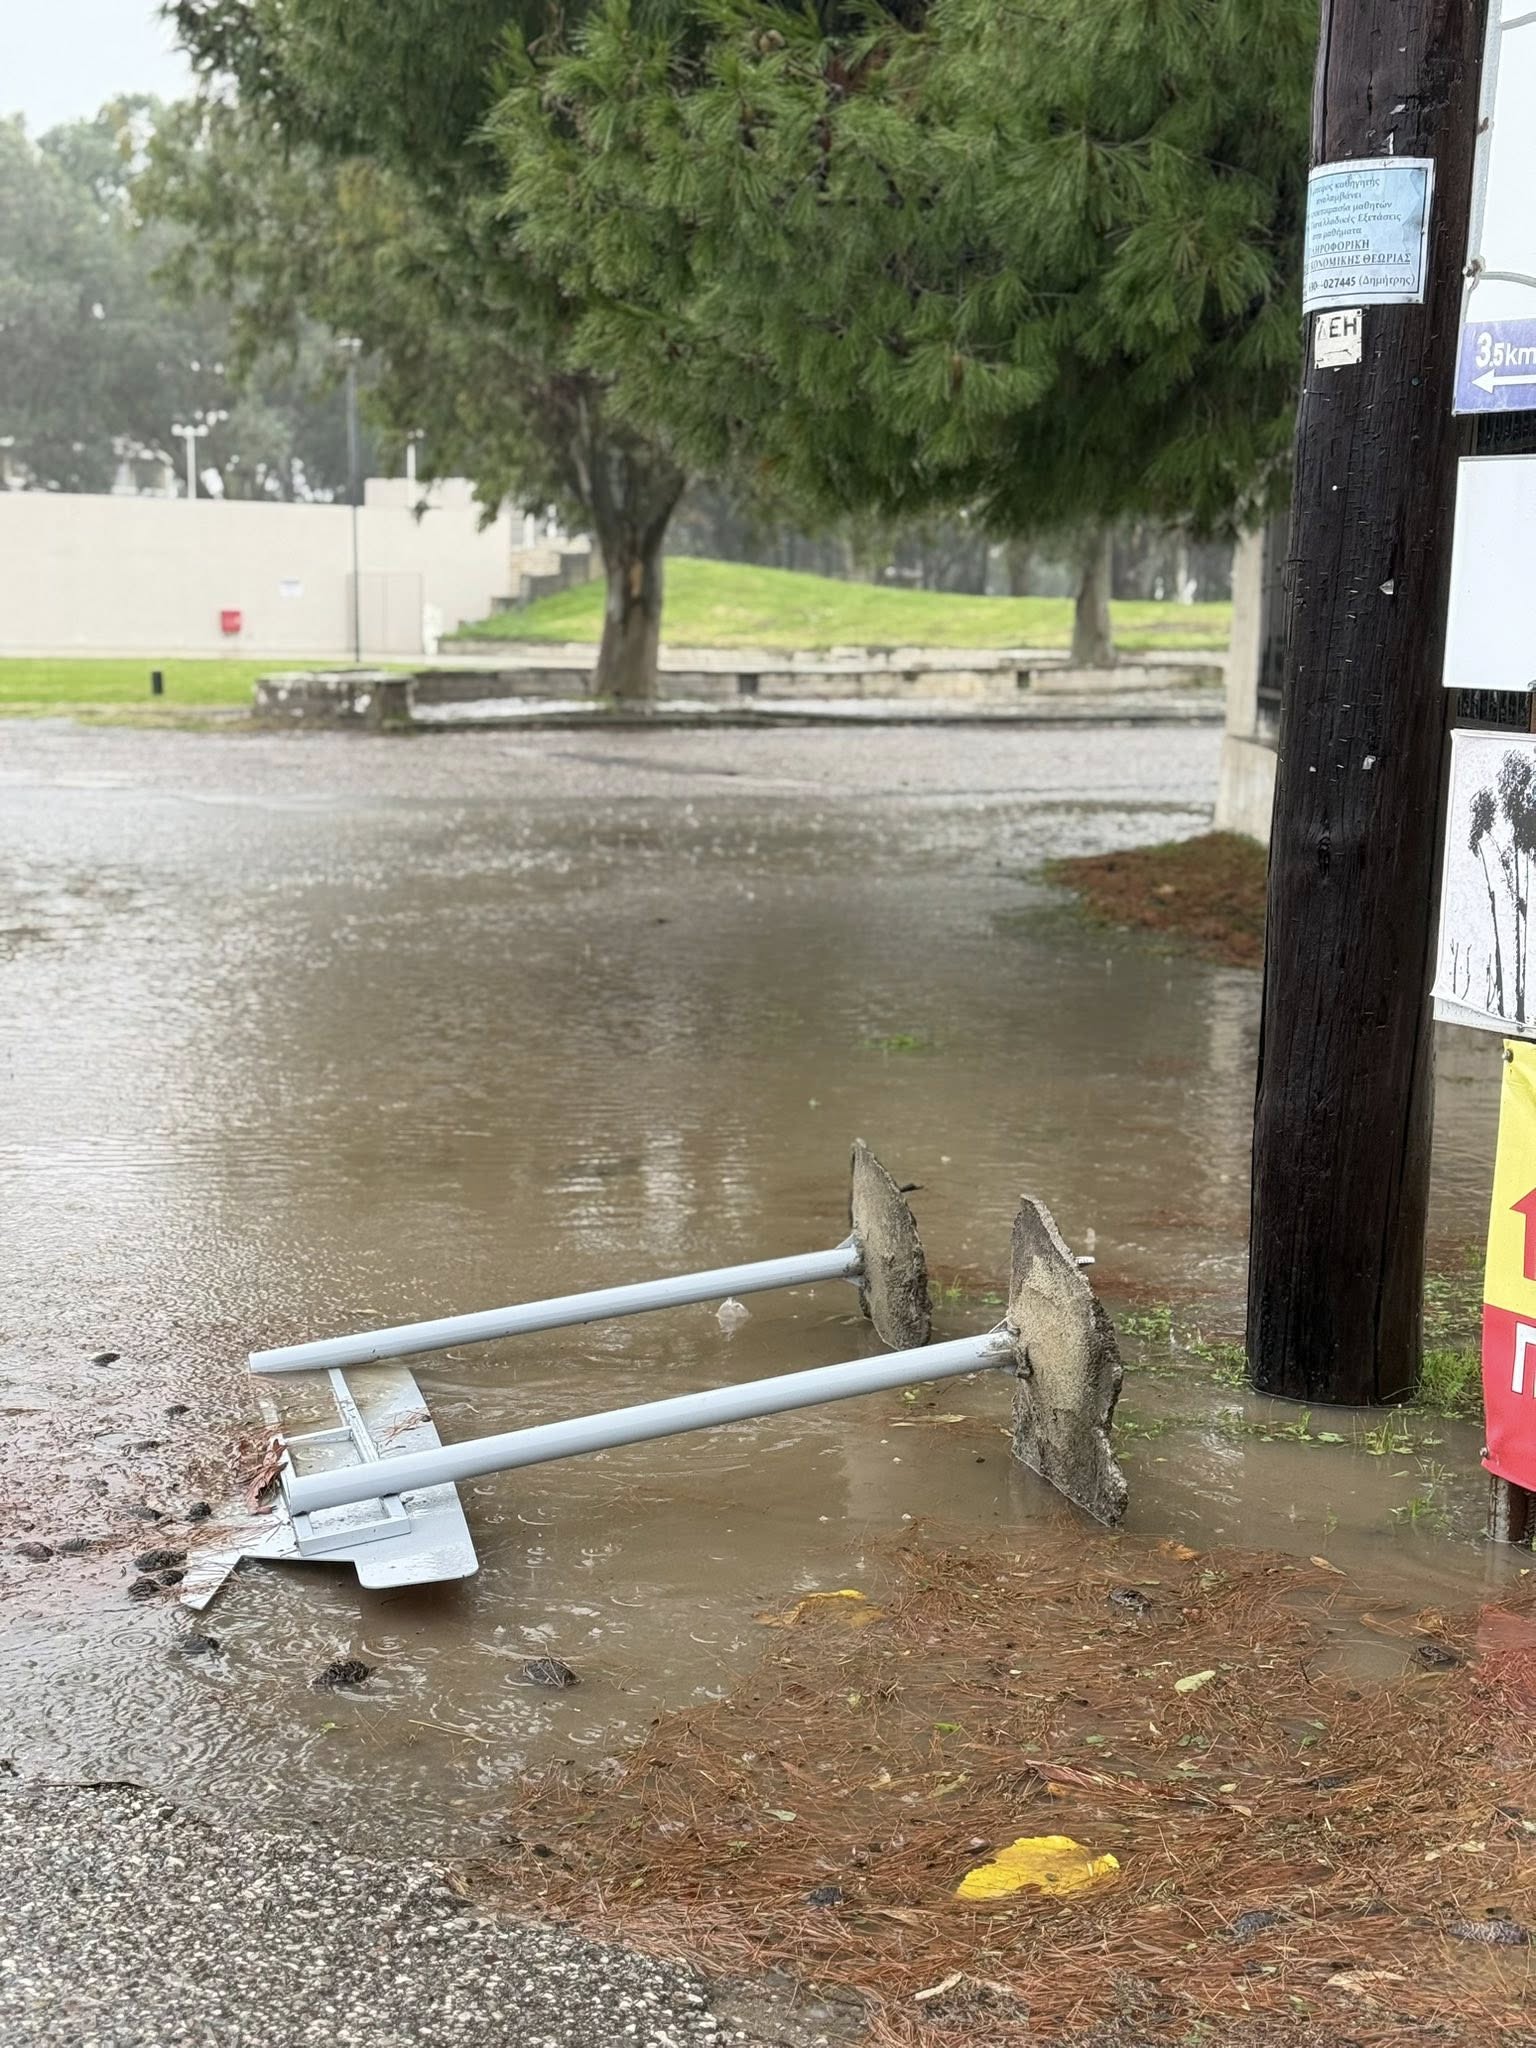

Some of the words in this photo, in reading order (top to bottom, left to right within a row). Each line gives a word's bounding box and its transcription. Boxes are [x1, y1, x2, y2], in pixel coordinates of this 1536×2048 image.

[1352, 200, 1392, 213] μαθητών
[1358, 211, 1402, 223] Εξετάσεις
[1362, 252, 1411, 264] ΘΕΩΡΙΑΣ
[1358, 273, 1416, 287] (Δημήτρης)
[1475, 331, 1536, 368] 3.5km
